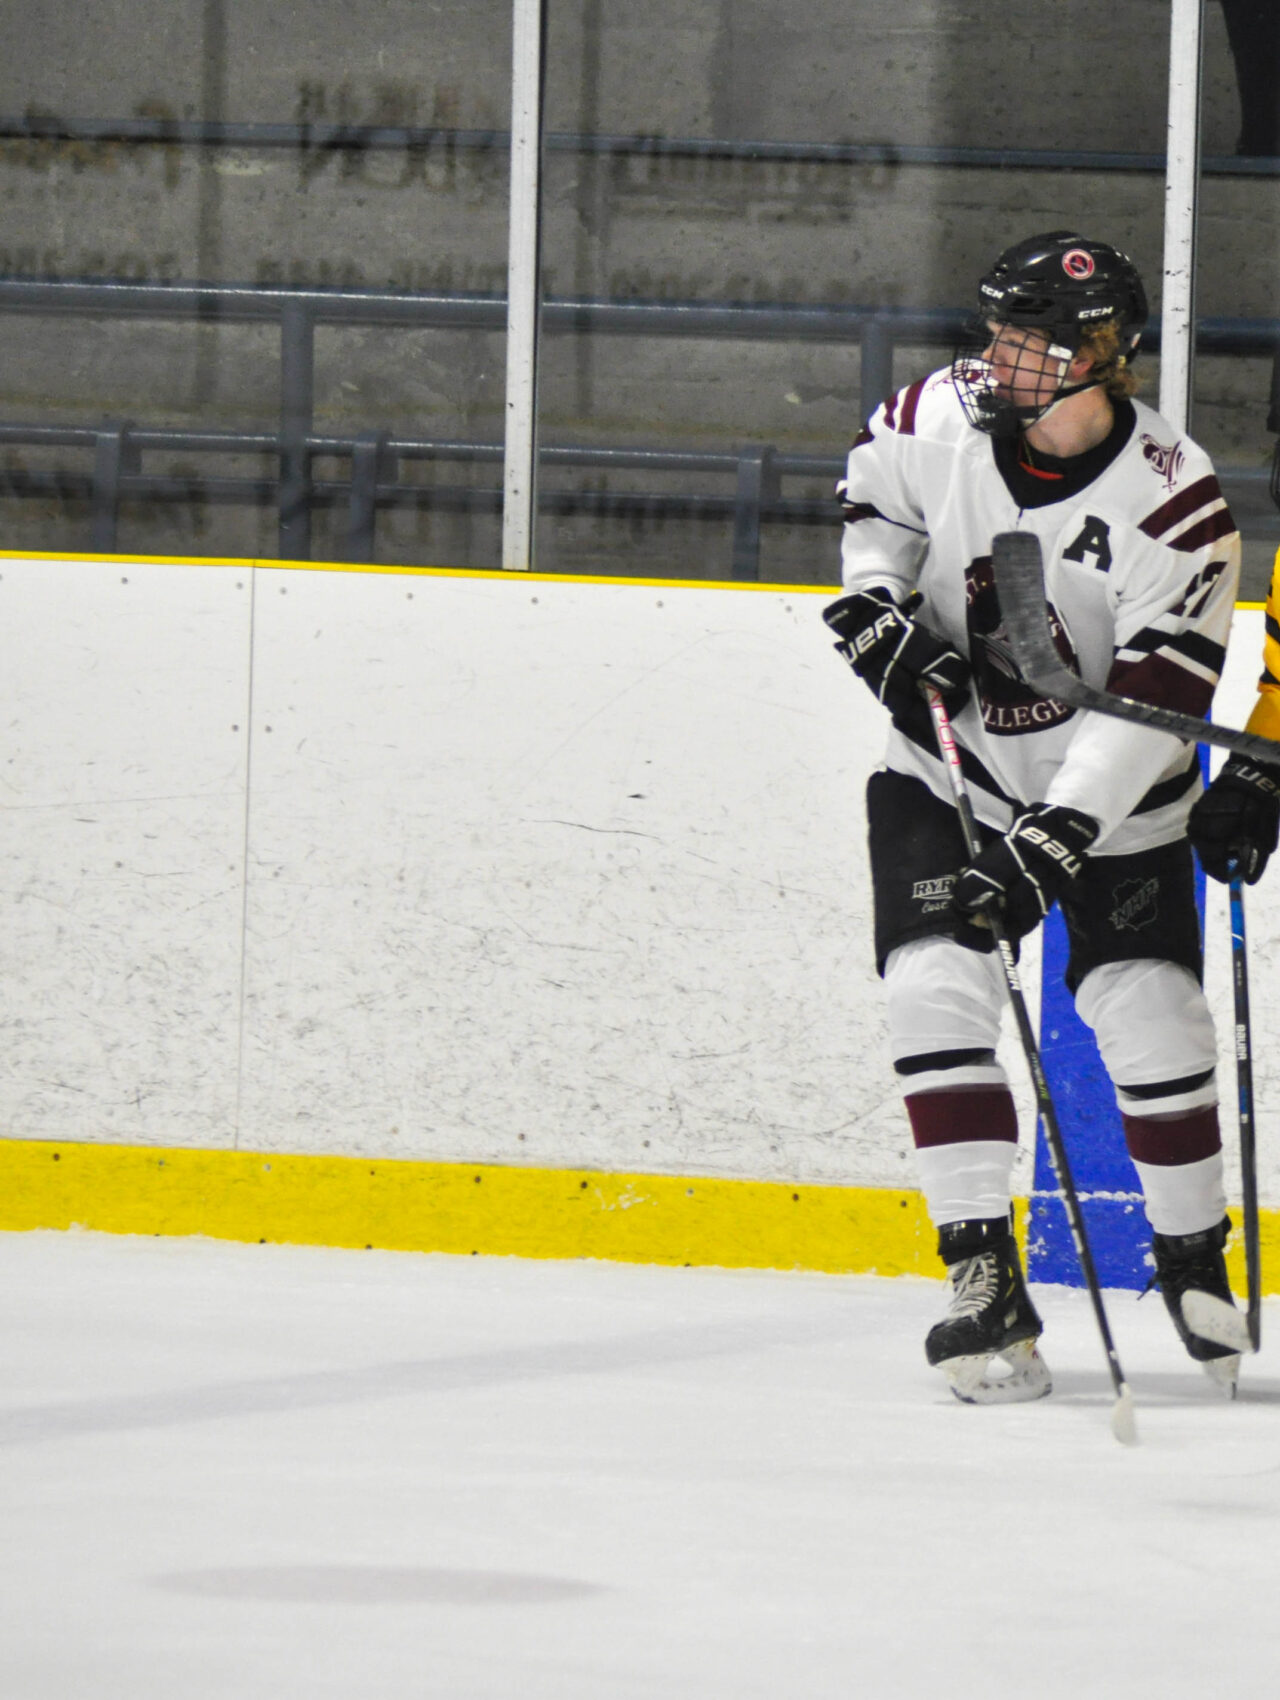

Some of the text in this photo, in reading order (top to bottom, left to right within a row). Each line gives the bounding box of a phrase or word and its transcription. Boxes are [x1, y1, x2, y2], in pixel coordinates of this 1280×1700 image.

[980, 284, 1005, 299] CCM
[1077, 306, 1113, 320] CCM
[1062, 515, 1113, 573] A
[983, 699, 1068, 729] LLEGE
